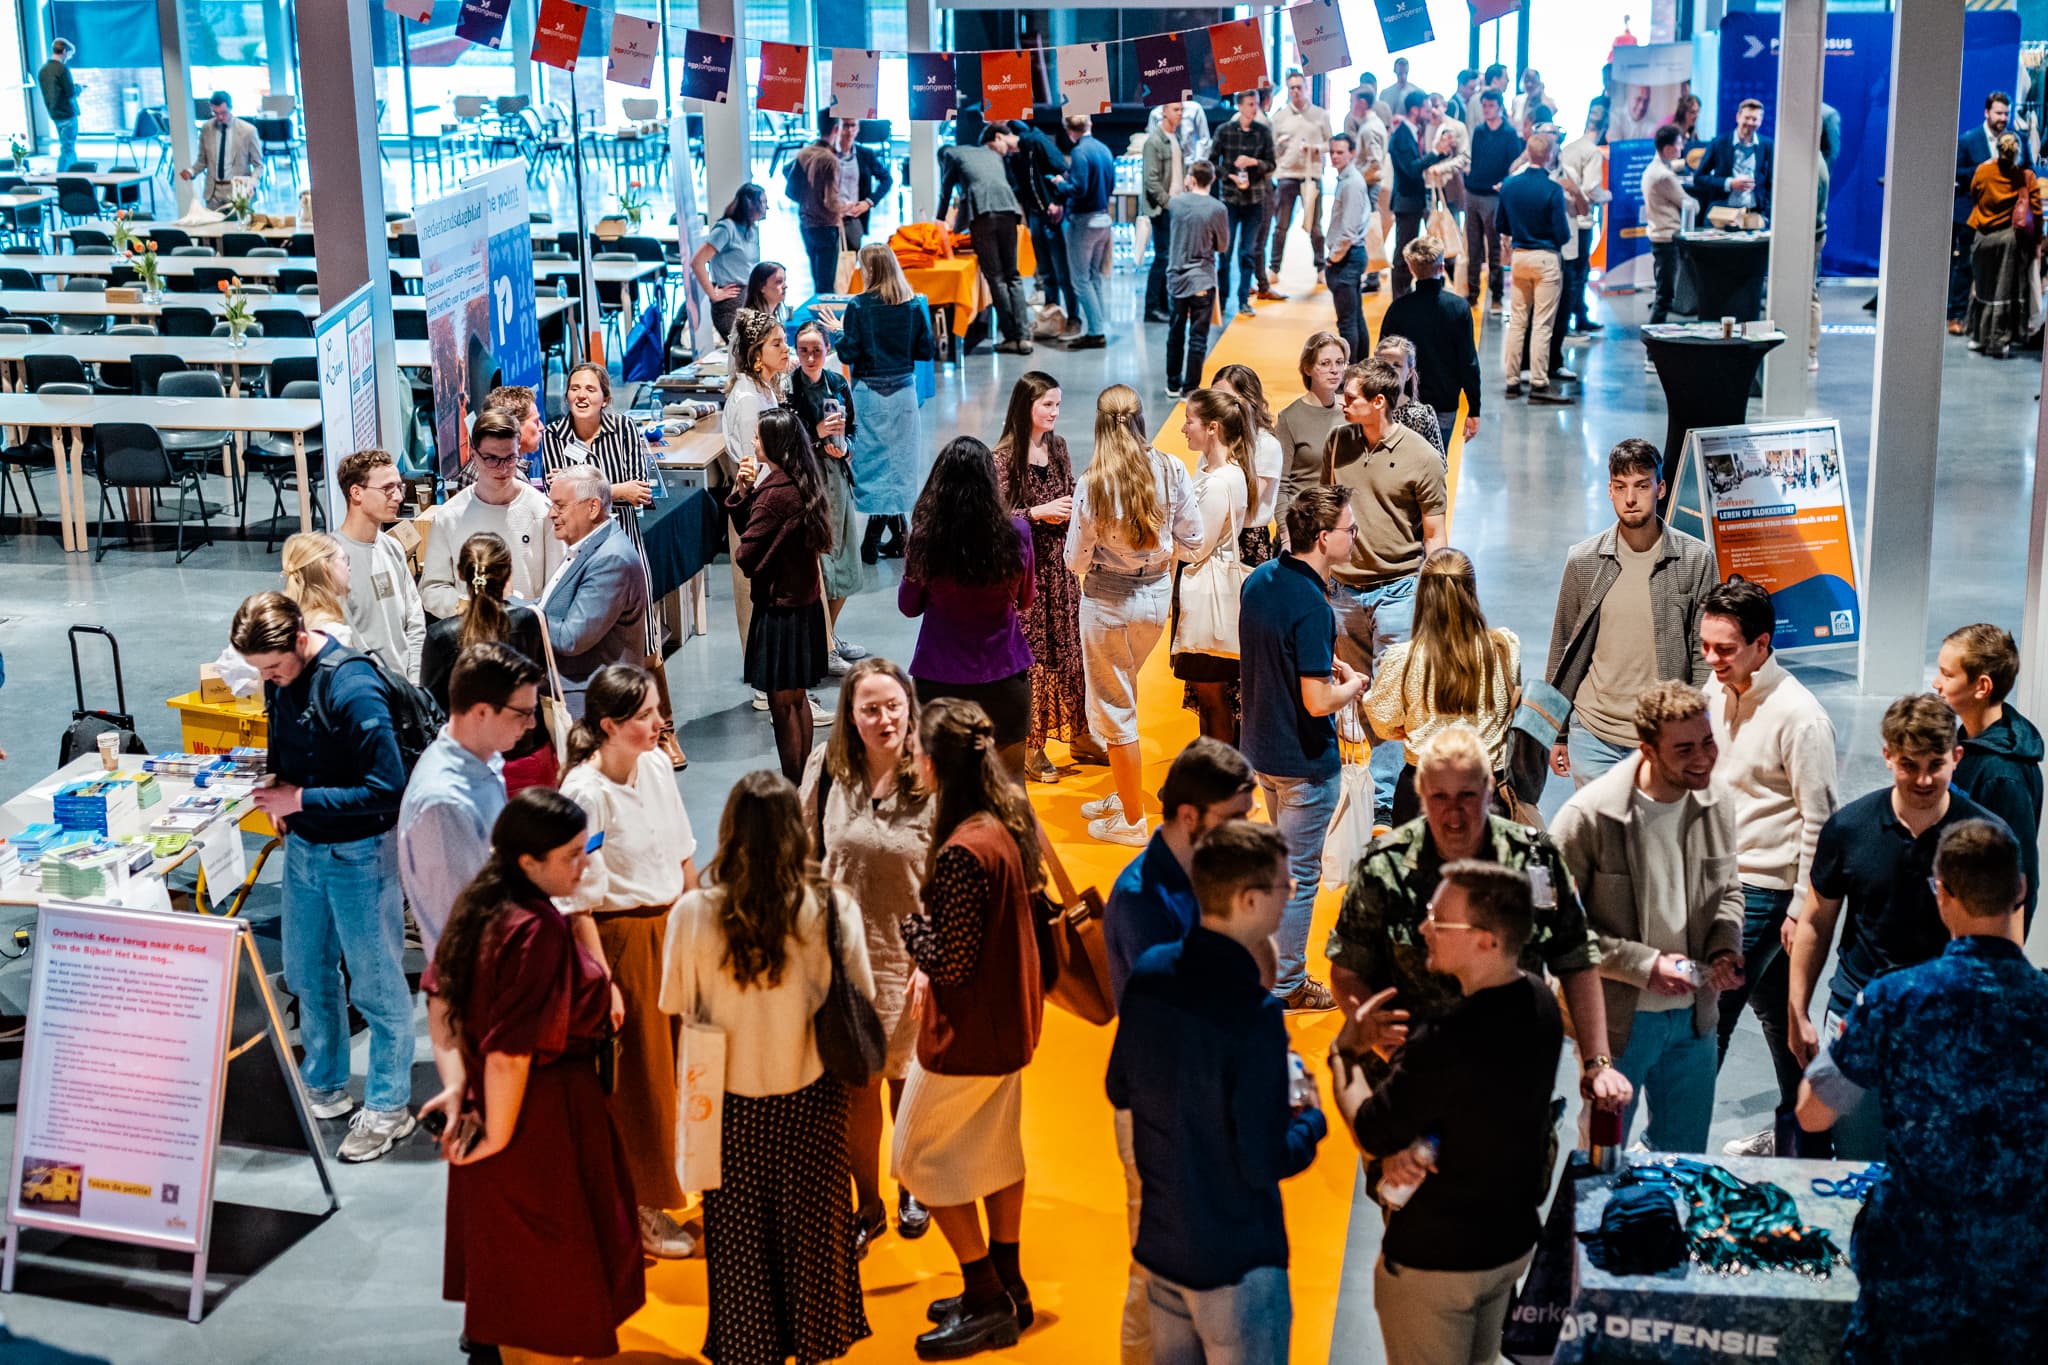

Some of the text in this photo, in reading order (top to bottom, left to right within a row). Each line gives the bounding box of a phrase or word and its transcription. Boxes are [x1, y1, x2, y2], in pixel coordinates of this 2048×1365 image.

[466, 4, 503, 20] sgpjongeren
[1384, 6, 1424, 24] sgpjongeren
[540, 27, 577, 42] sgpjongeren
[1302, 31, 1340, 46] sgpjongeren
[614, 46, 650, 58] sgpjongeren
[1220, 50, 1260, 65] sgpjongeren
[688, 62, 726, 74] sgpjongeren
[1144, 64, 1184, 78] sgpjongeren
[763, 74, 802, 84] sgpjongeren
[836, 82, 875, 90] sgpjongeren
[1064, 76, 1104, 86] sgpjongeren
[912, 83, 952, 92] sgpjongeren
[987, 82, 1027, 92] sgpjongeren
[498, 184, 518, 214] point
[1719, 506, 1795, 520] LEREN OF BLOKKEREN?
[193, 741, 210, 754] We
[52, 928, 207, 954] Overheid: Keer terug naar de God
[70, 944, 80, 952] de
[84, 946, 113, 957] Bijbel!
[115, 950, 130, 959] Het
[132, 953, 148, 961] kan
[112, 1184, 122, 1192] de
[123, 1184, 152, 1196] petitie!
[1604, 1315, 1779, 1357] DEFENSIE
